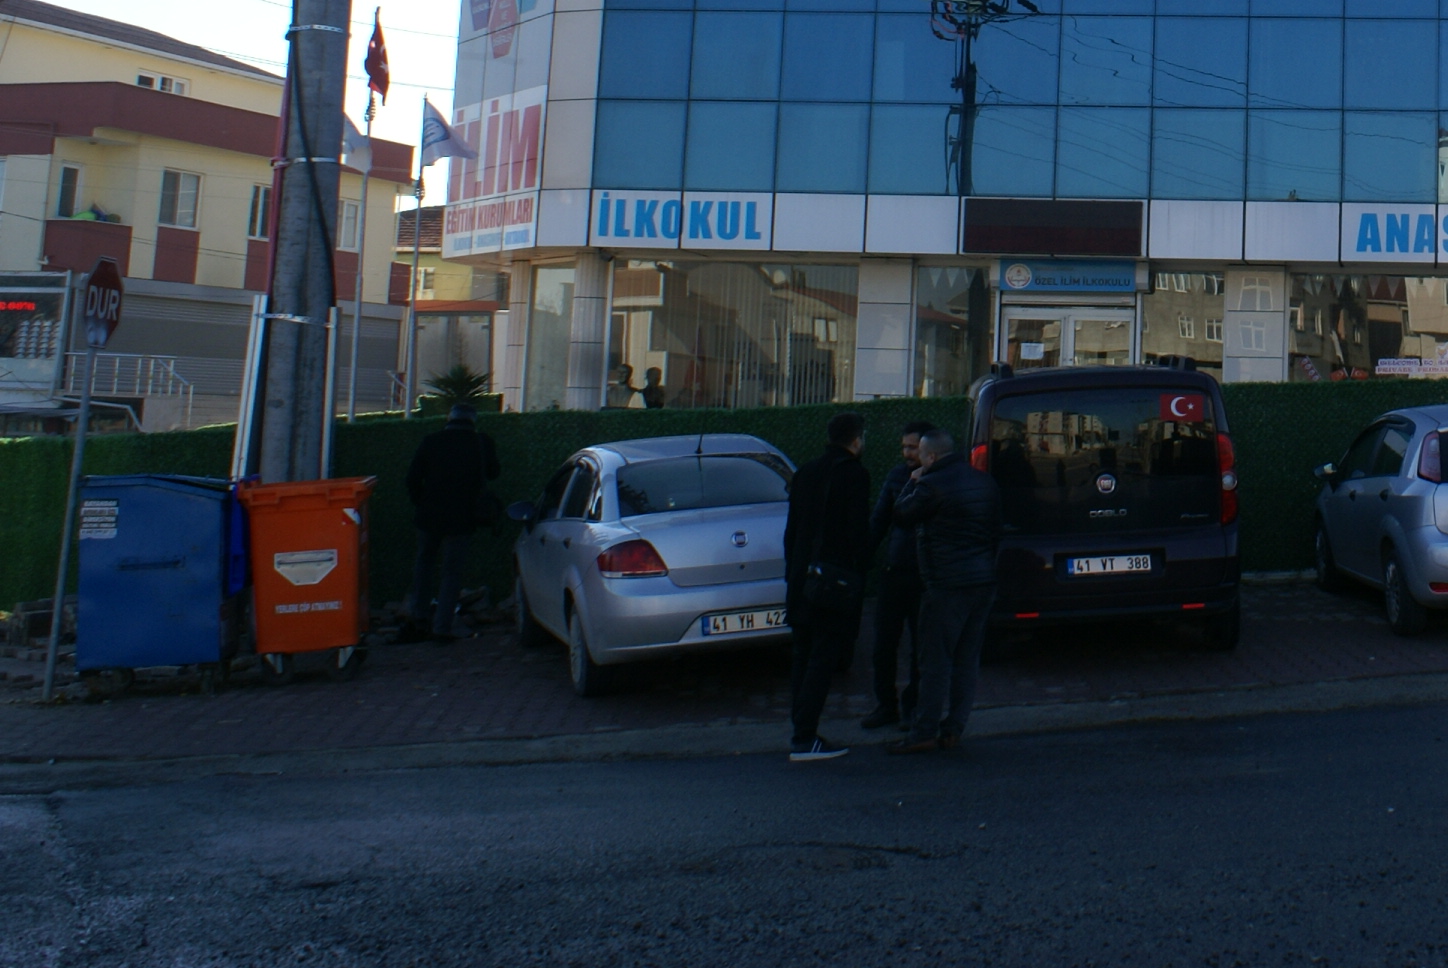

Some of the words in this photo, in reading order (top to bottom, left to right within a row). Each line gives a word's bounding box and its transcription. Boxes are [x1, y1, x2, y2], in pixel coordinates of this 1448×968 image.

[449, 100, 541, 202] İLİM
[478, 197, 533, 230] KURUMLARI
[598, 192, 761, 241] İLKOKUL
[1034, 276, 1057, 286] ÖZEL
[1060, 276, 1080, 286] İLİM
[1083, 276, 1131, 287] İLKOKULU
[86, 285, 119, 321] DUR
[1076, 560, 1090, 572] 41
[1101, 558, 1114, 570] VT
[1127, 557, 1149, 569] 388
[713, 616, 727, 631] 41
[739, 613, 754, 629] YH
